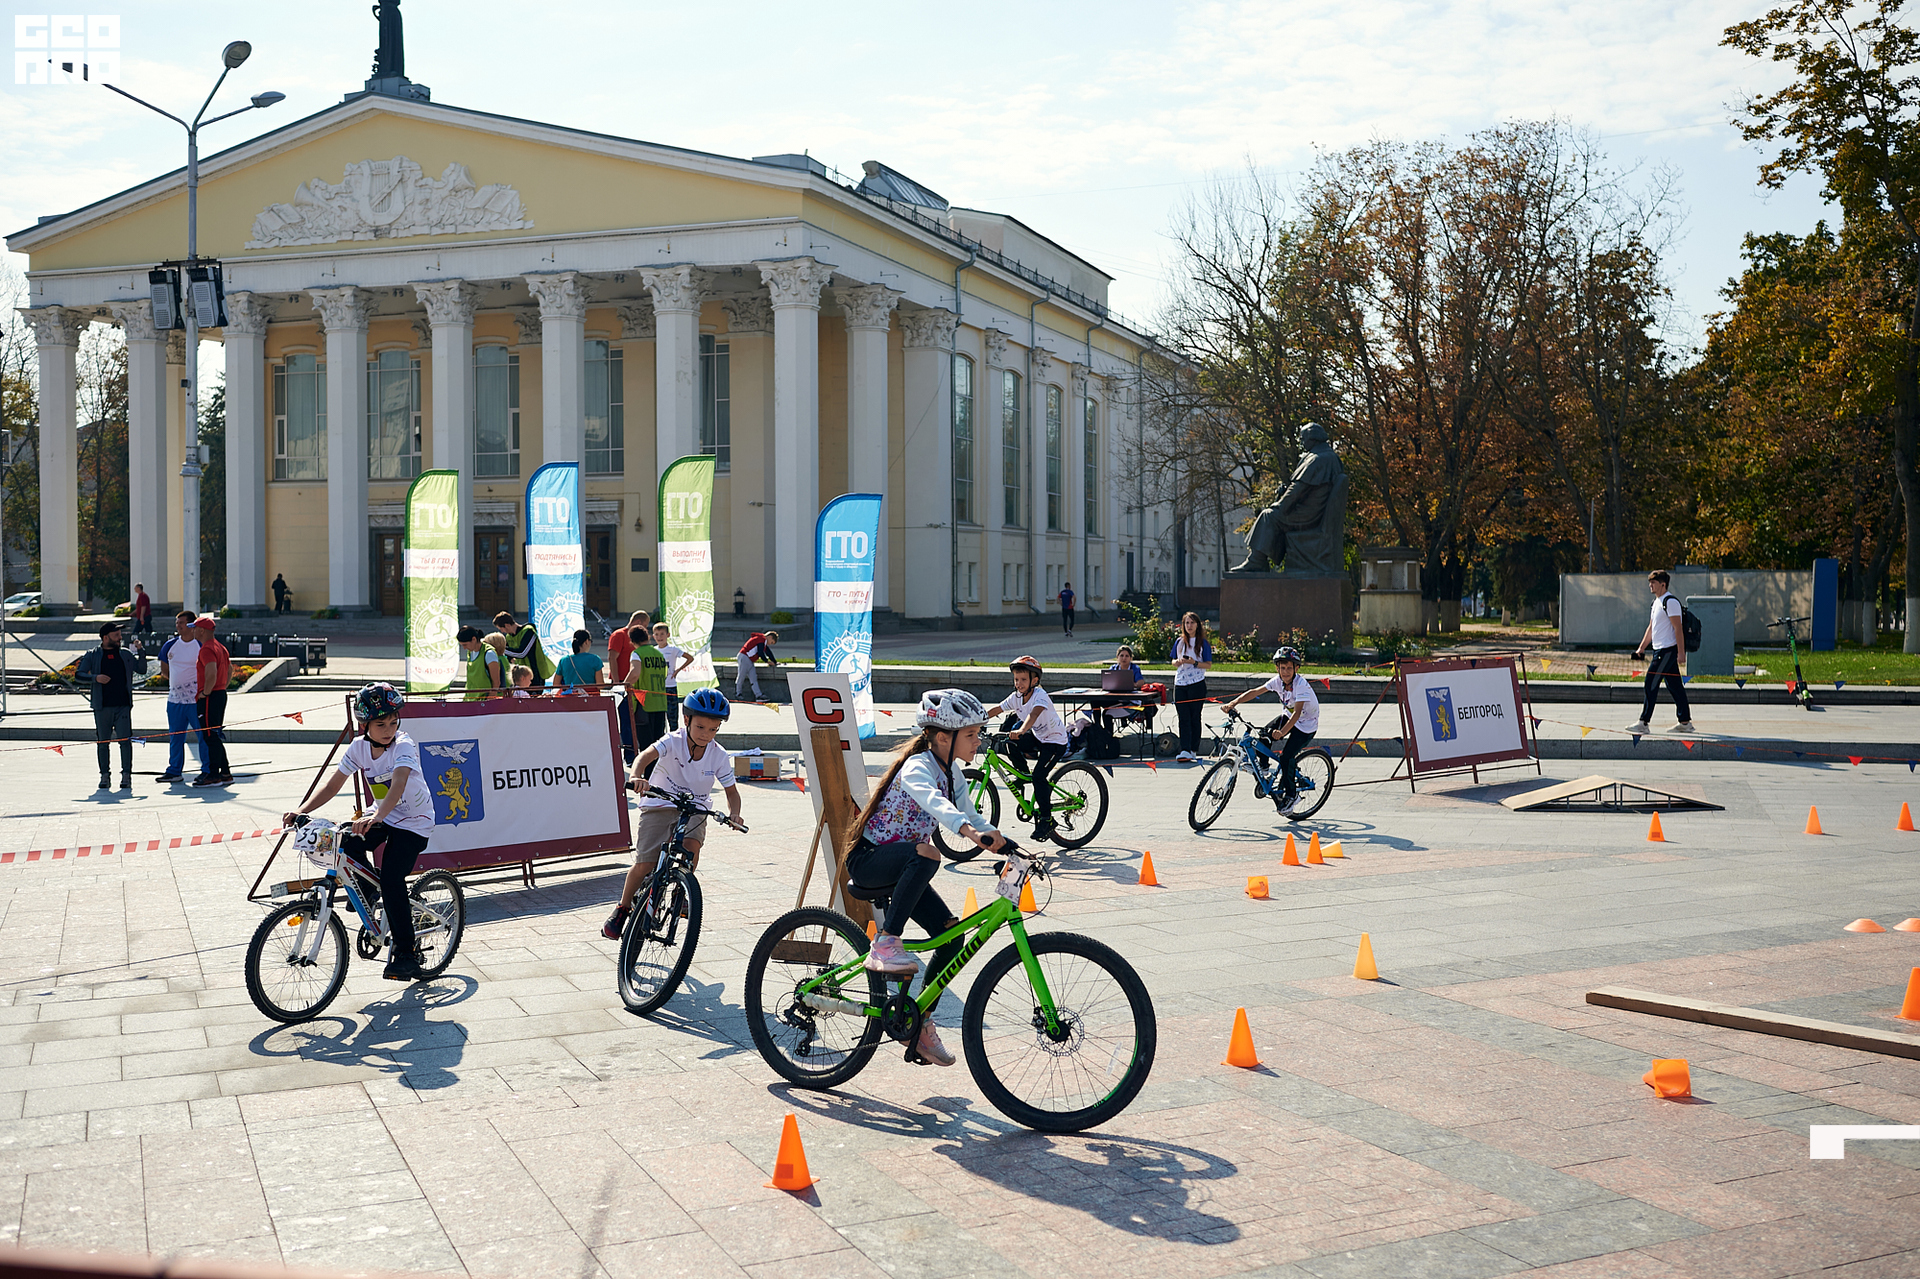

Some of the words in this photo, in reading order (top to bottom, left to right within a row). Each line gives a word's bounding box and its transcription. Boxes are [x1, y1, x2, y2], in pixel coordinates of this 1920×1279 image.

[414, 503, 451, 528] ГТО
[534, 497, 569, 523] ГТО
[666, 492, 703, 519] ГТО
[825, 531, 868, 558] ГТО
[827, 590, 842, 598] ГТО
[1457, 704, 1504, 720] БЕЛГОРОД
[492, 765, 592, 791] БЕЛГОРОД
[297, 827, 320, 844] 35
